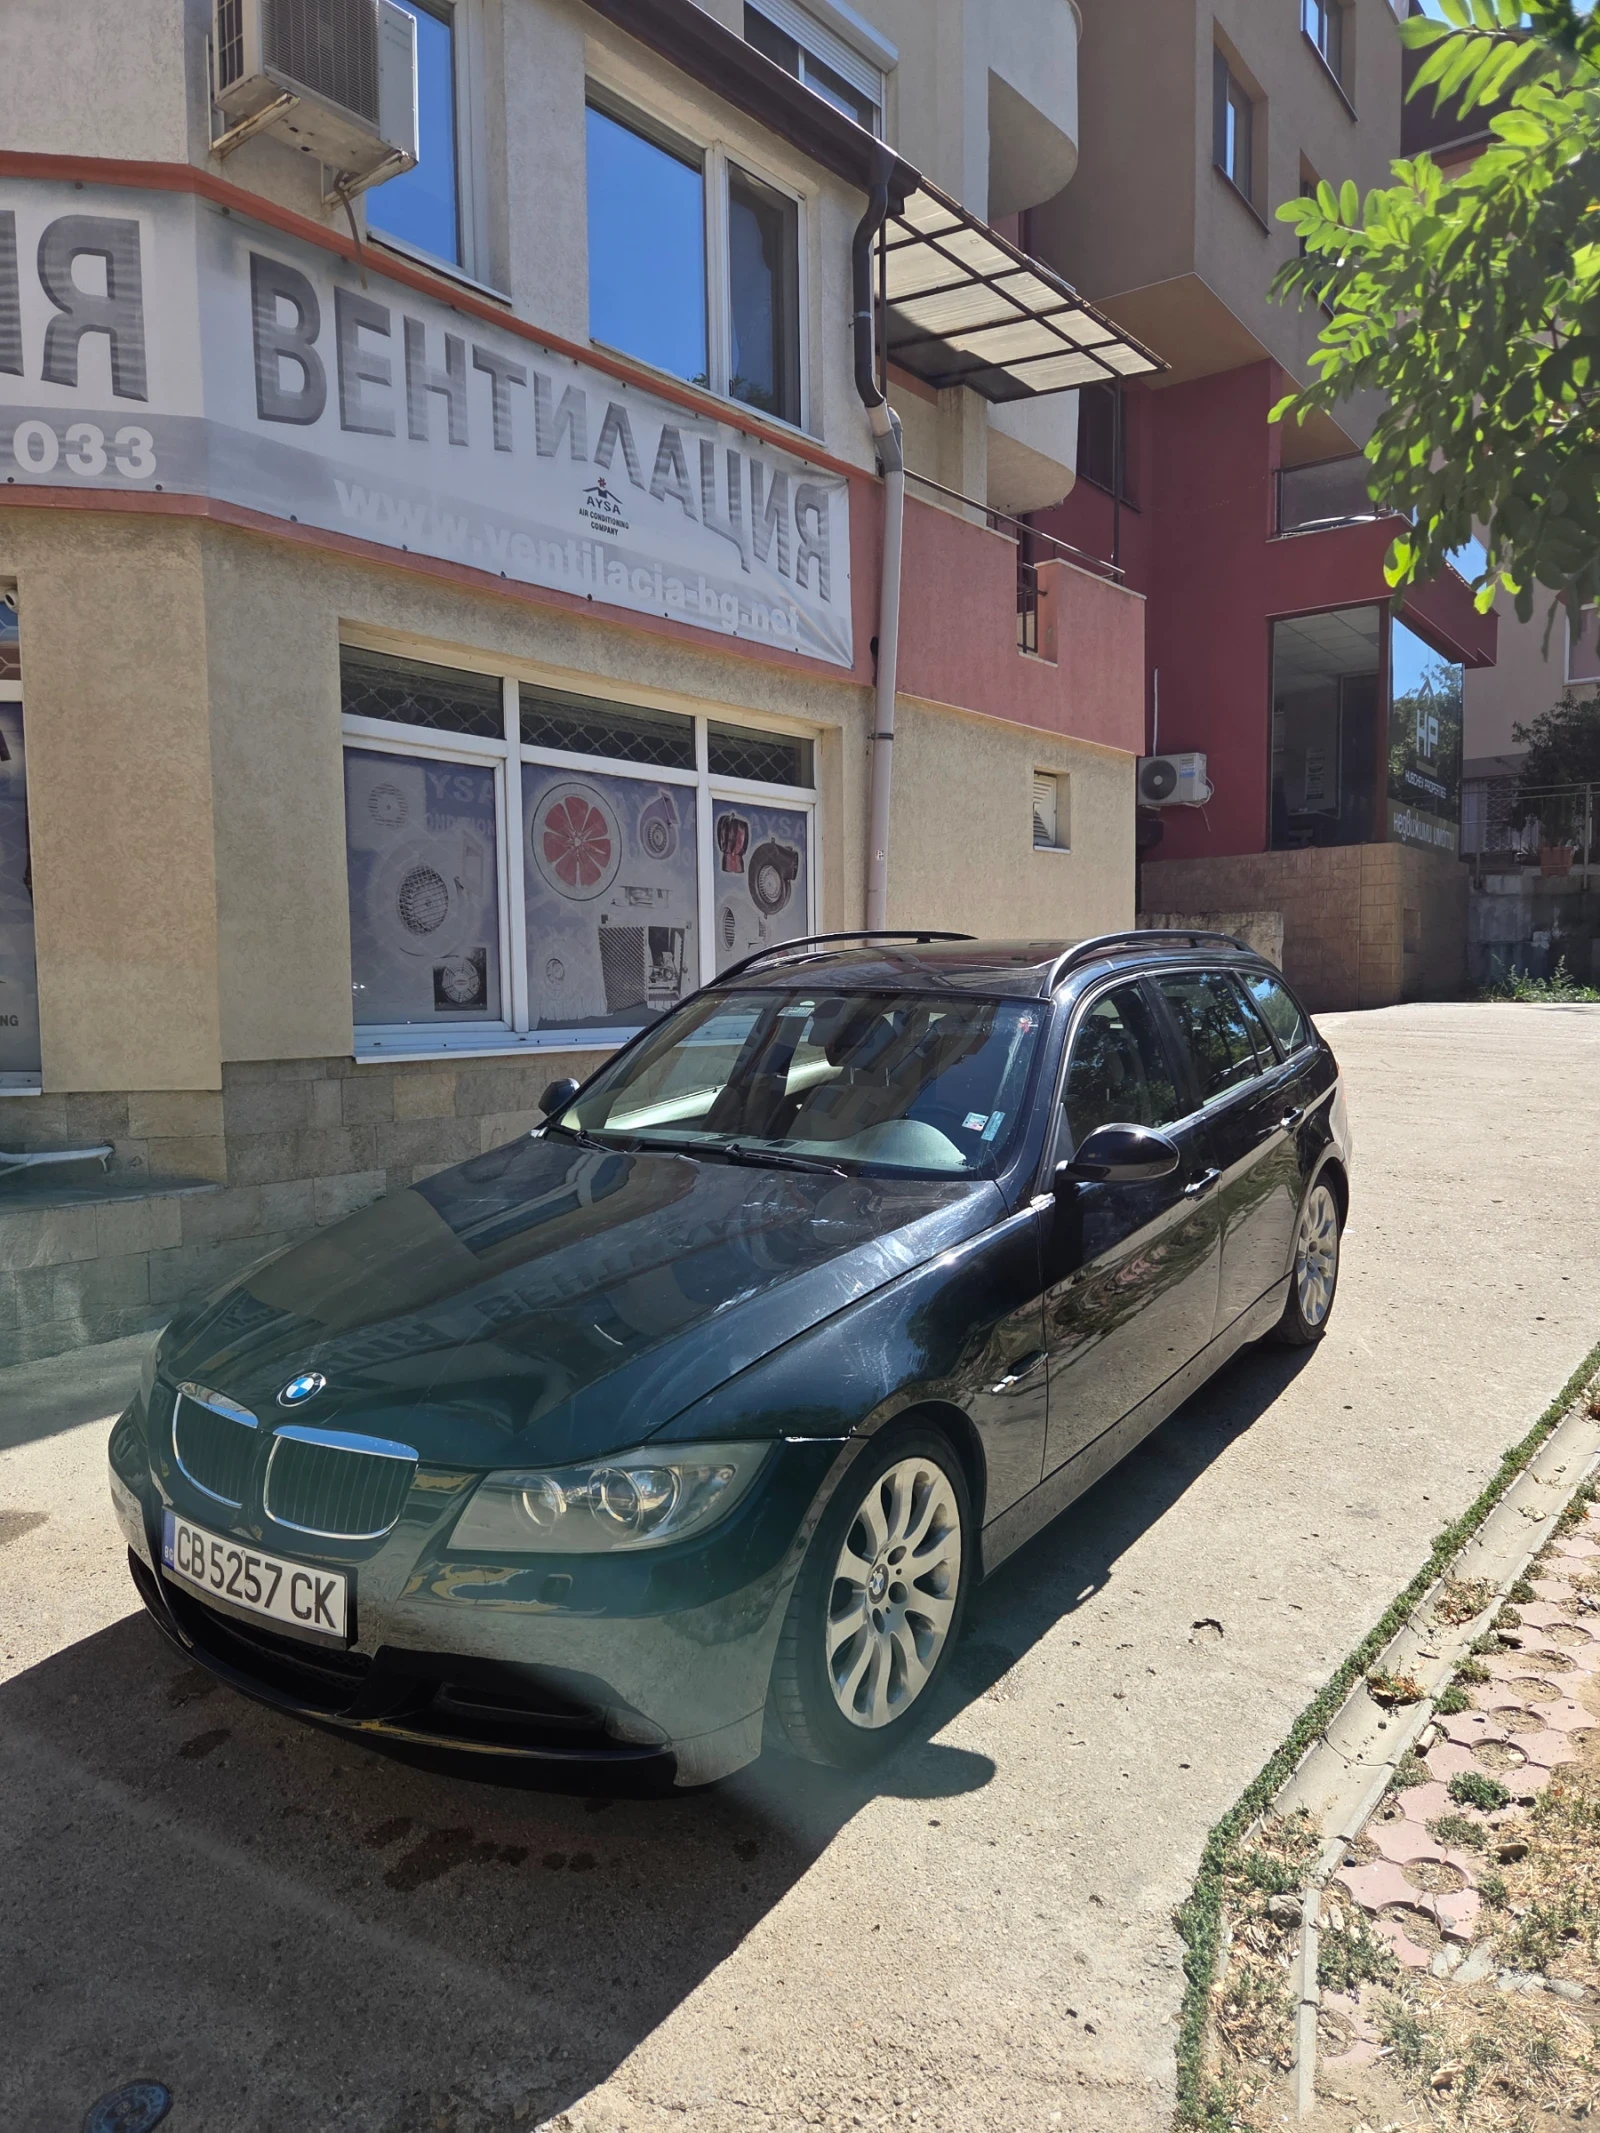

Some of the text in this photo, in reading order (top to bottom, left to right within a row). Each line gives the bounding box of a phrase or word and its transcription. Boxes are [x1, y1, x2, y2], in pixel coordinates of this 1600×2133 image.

[13, 420, 157, 479] 033
[249, 251, 831, 602] ВЕНТИЛАЦИЯ
[579, 508, 630, 529] AIR CONDITIONING
[586, 495, 621, 515] AYSA
[590, 521, 619, 536] COMPANY
[333, 478, 801, 635] www.ventilacia-bg.net
[1416, 709, 1439, 759] HP
